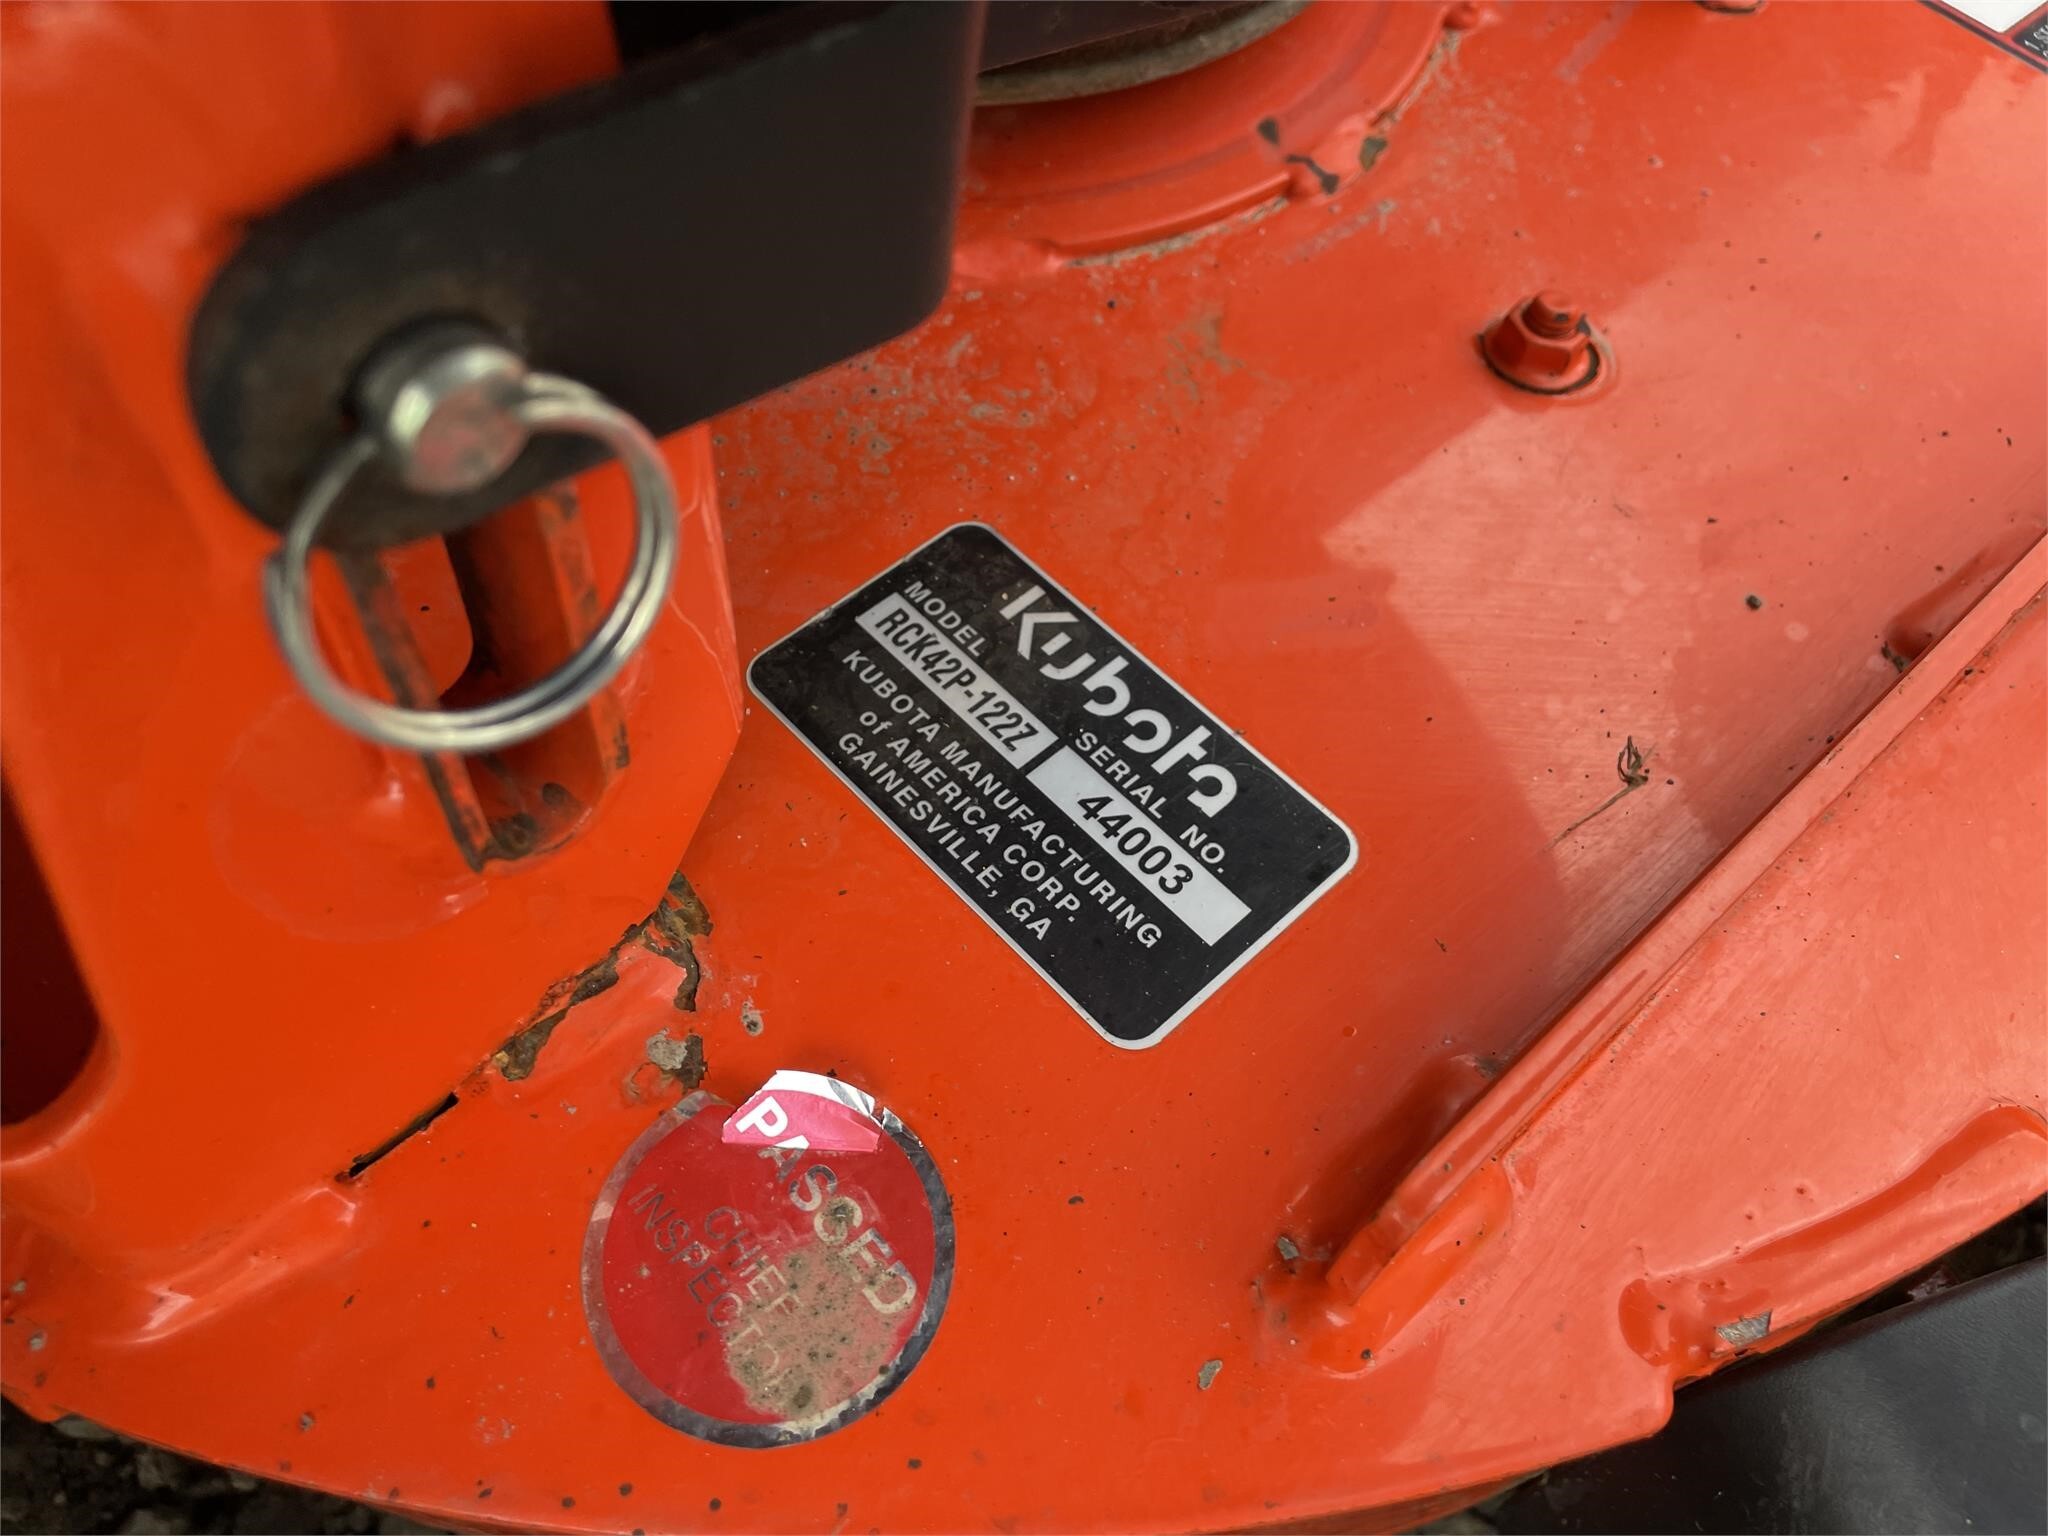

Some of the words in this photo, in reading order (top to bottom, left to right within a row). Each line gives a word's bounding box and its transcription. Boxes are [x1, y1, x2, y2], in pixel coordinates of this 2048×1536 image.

[874, 608, 1039, 752] RCK42P-122Z
[904, 580, 985, 656] MODEL
[1001, 584, 1238, 816] Kubota
[838, 734, 999, 899] GAINESVILLE,
[1008, 896, 1052, 941] GA
[842, 650, 939, 743] KUBOTA
[939, 739, 1163, 949] MANUFACTURING
[858, 706, 891, 739] of
[886, 735, 999, 843] AMERICA
[1004, 834, 1081, 923] CORP.
[1074, 729, 1167, 819] SERIAL
[1180, 825, 1227, 874] NO.
[1078, 790, 1193, 895] 44003
